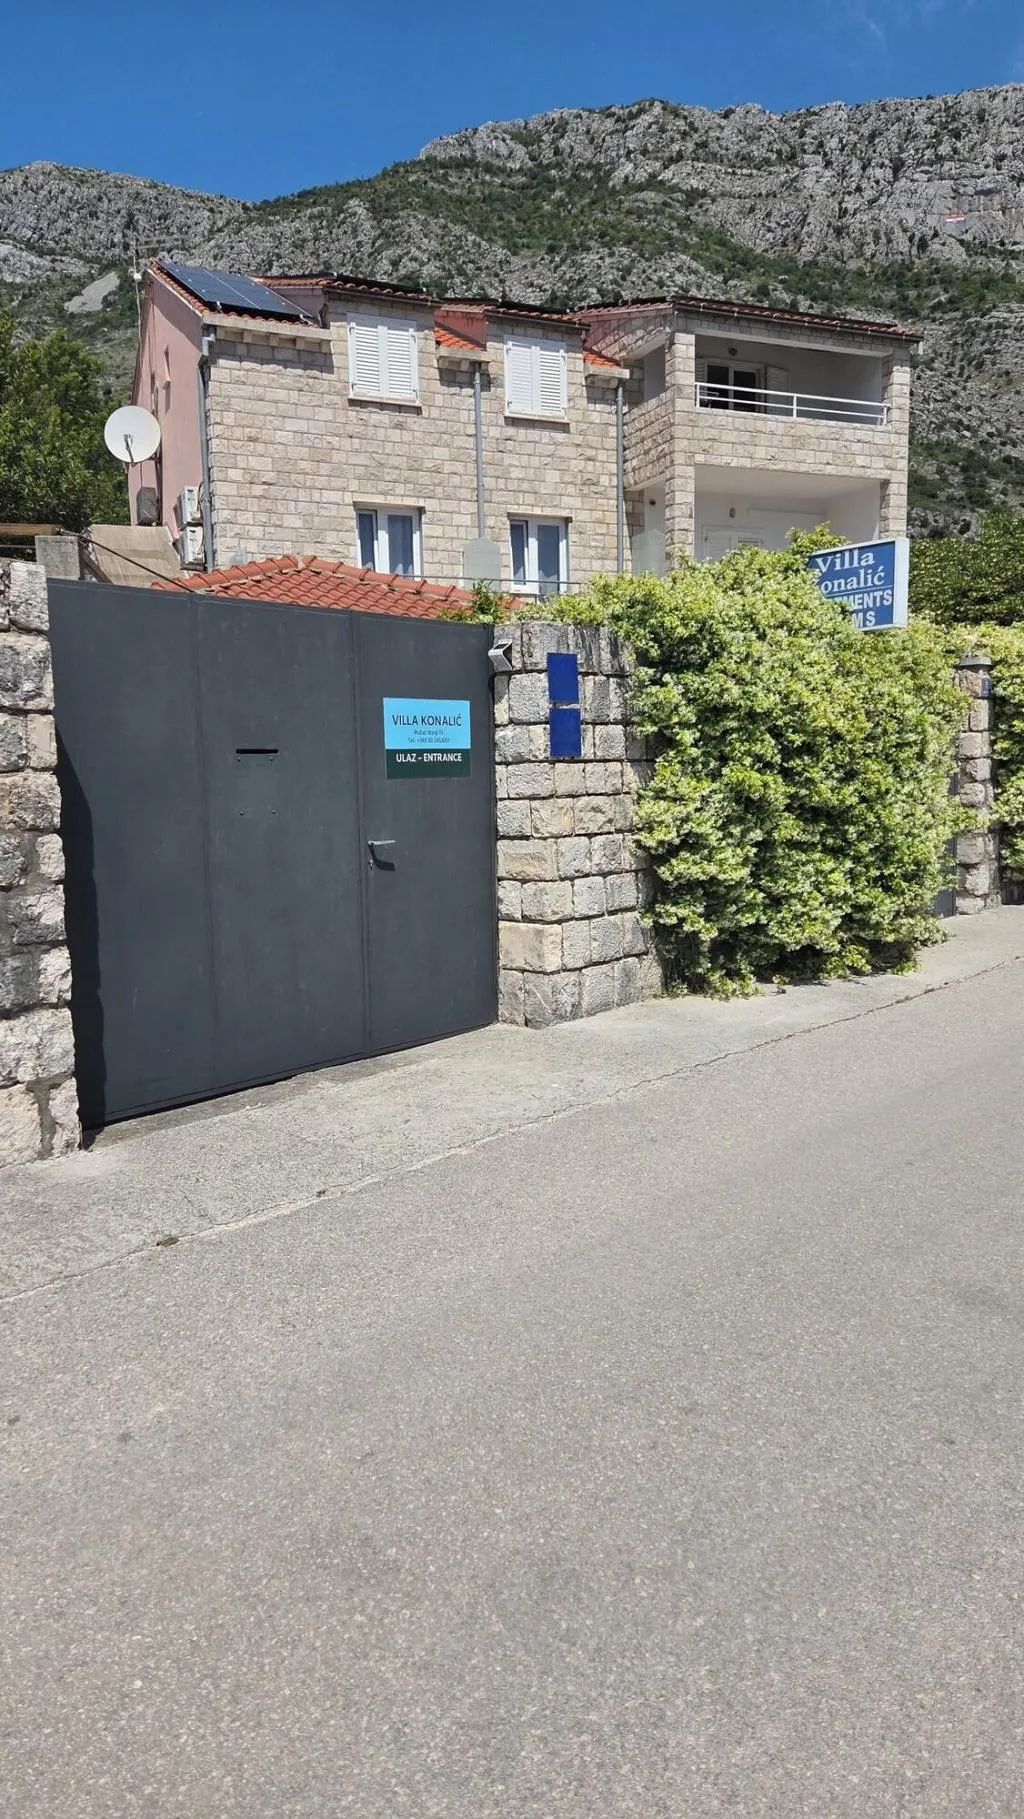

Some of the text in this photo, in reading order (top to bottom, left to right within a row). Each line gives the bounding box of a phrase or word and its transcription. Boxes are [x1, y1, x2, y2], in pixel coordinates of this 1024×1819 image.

[815, 548, 875, 573] Villa
[820, 565, 885, 593] onalić
[391, 714, 419, 726] VILLA
[395, 753, 417, 763] ULAZ
[423, 752, 463, 762] ENTRANCE
